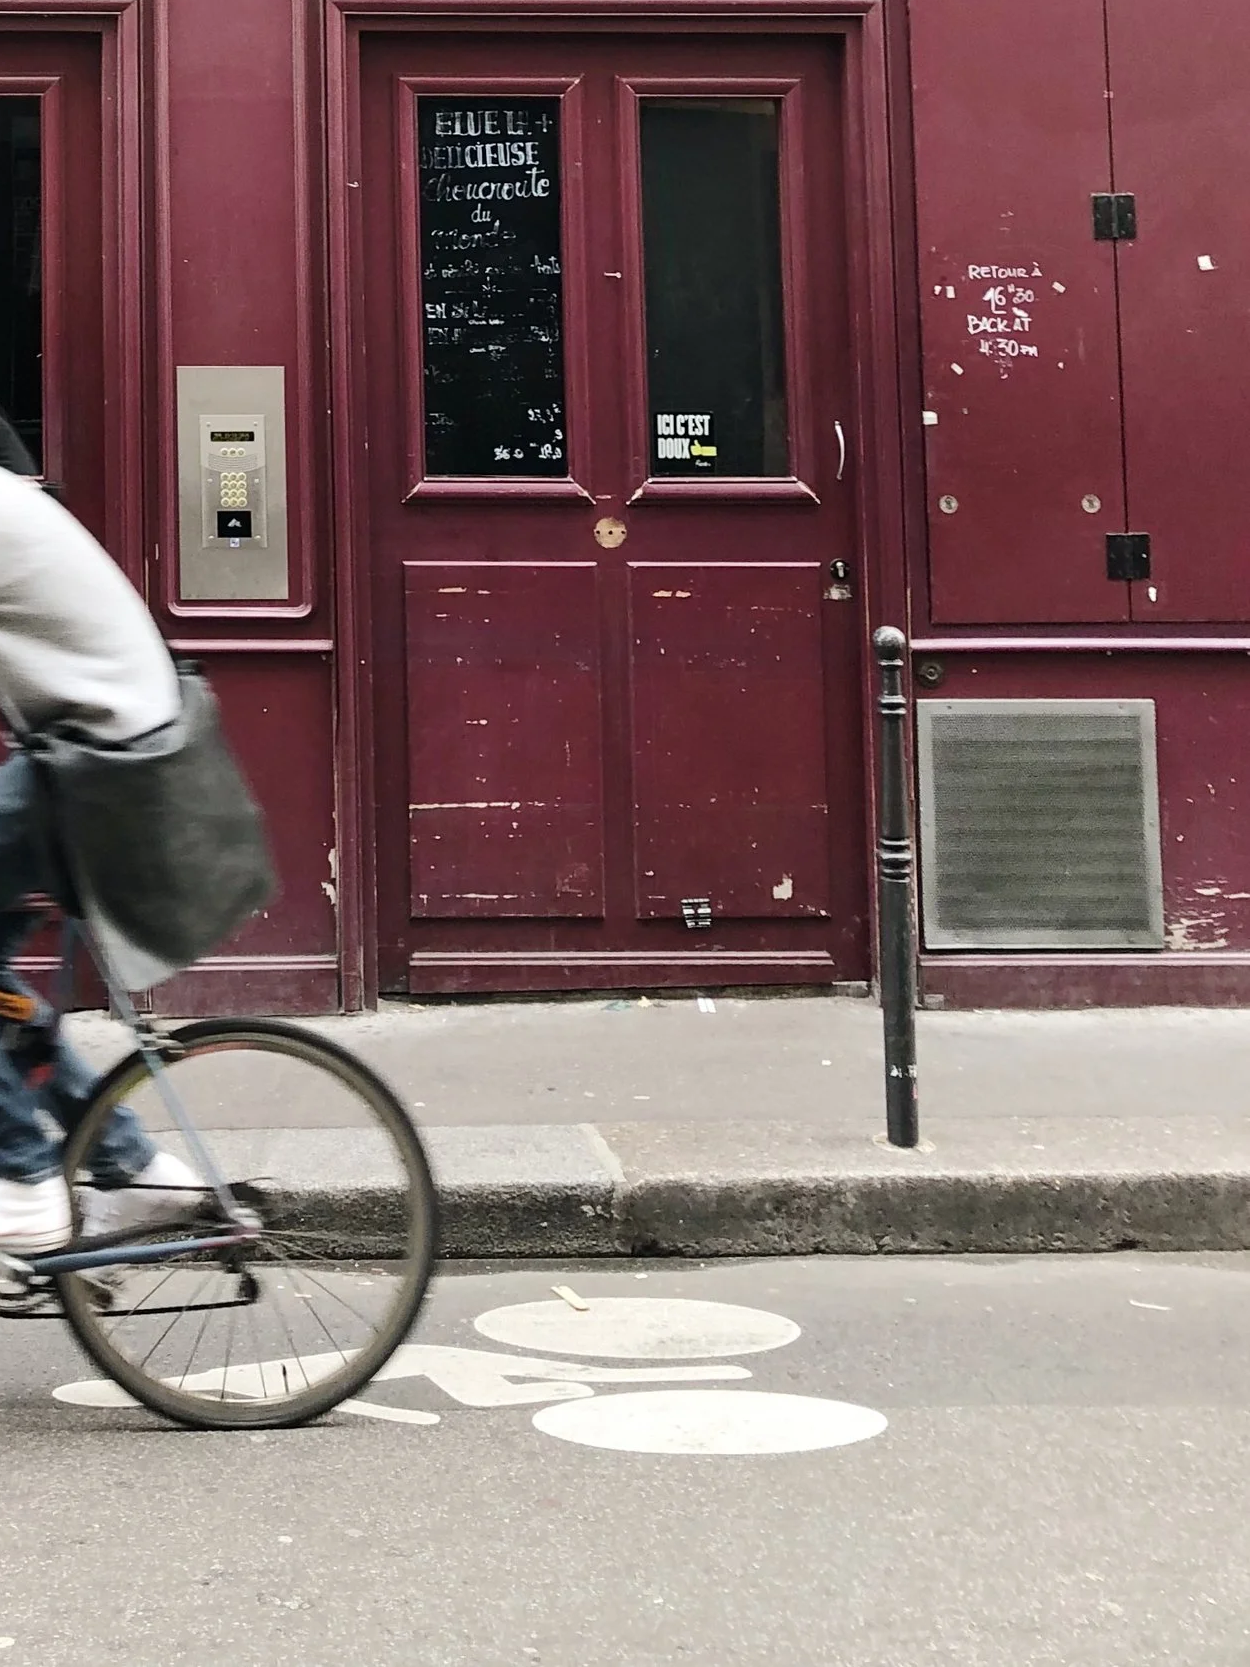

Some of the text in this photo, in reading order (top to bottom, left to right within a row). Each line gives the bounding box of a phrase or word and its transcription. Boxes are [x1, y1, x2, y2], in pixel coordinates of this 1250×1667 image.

[471, 203, 492, 223] du
[968, 264, 1030, 280] RETOUR
[967, 314, 1033, 335] BACK AT
[657, 414, 711, 436] ICI C'EST
[657, 437, 691, 460] DOUX
